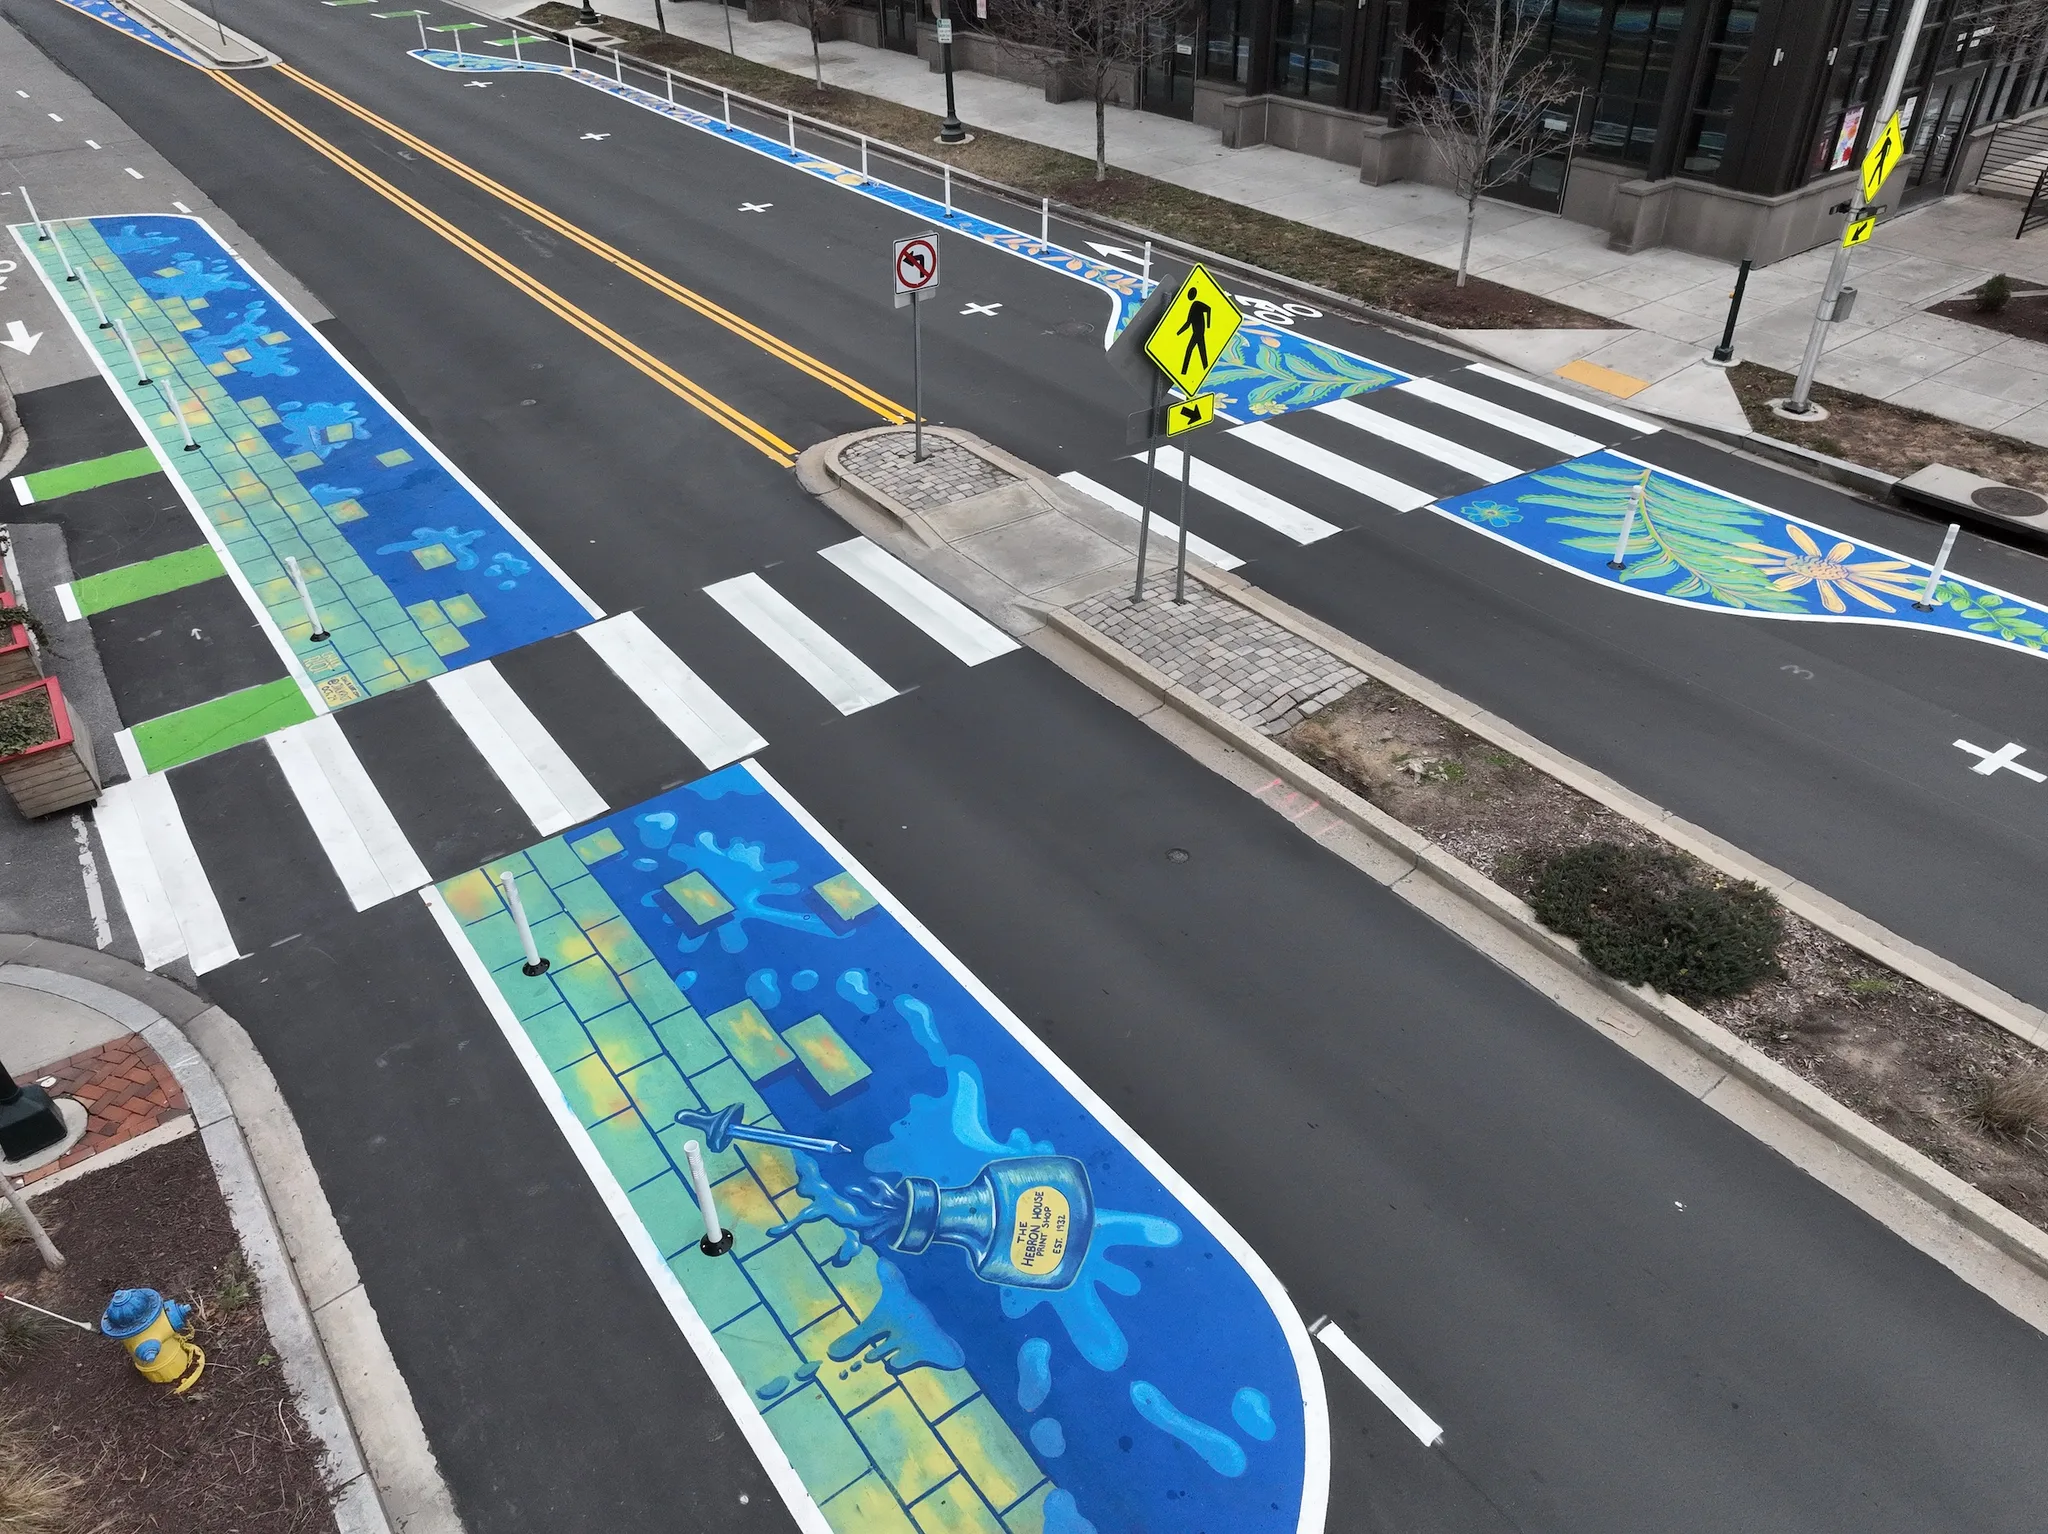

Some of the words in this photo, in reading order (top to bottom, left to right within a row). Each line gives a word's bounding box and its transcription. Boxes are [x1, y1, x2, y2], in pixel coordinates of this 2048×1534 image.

[1017, 1221, 1028, 1244] THE
[1021, 1225, 1041, 1267] HEBRON
[1032, 1191, 1044, 1219] HOUSE
[1036, 1233, 1048, 1256] PRINT
[1042, 1206, 1052, 1228] SHOP
[1056, 1215, 1066, 1232] 1932
[1053, 1237, 1063, 1254] EST.
